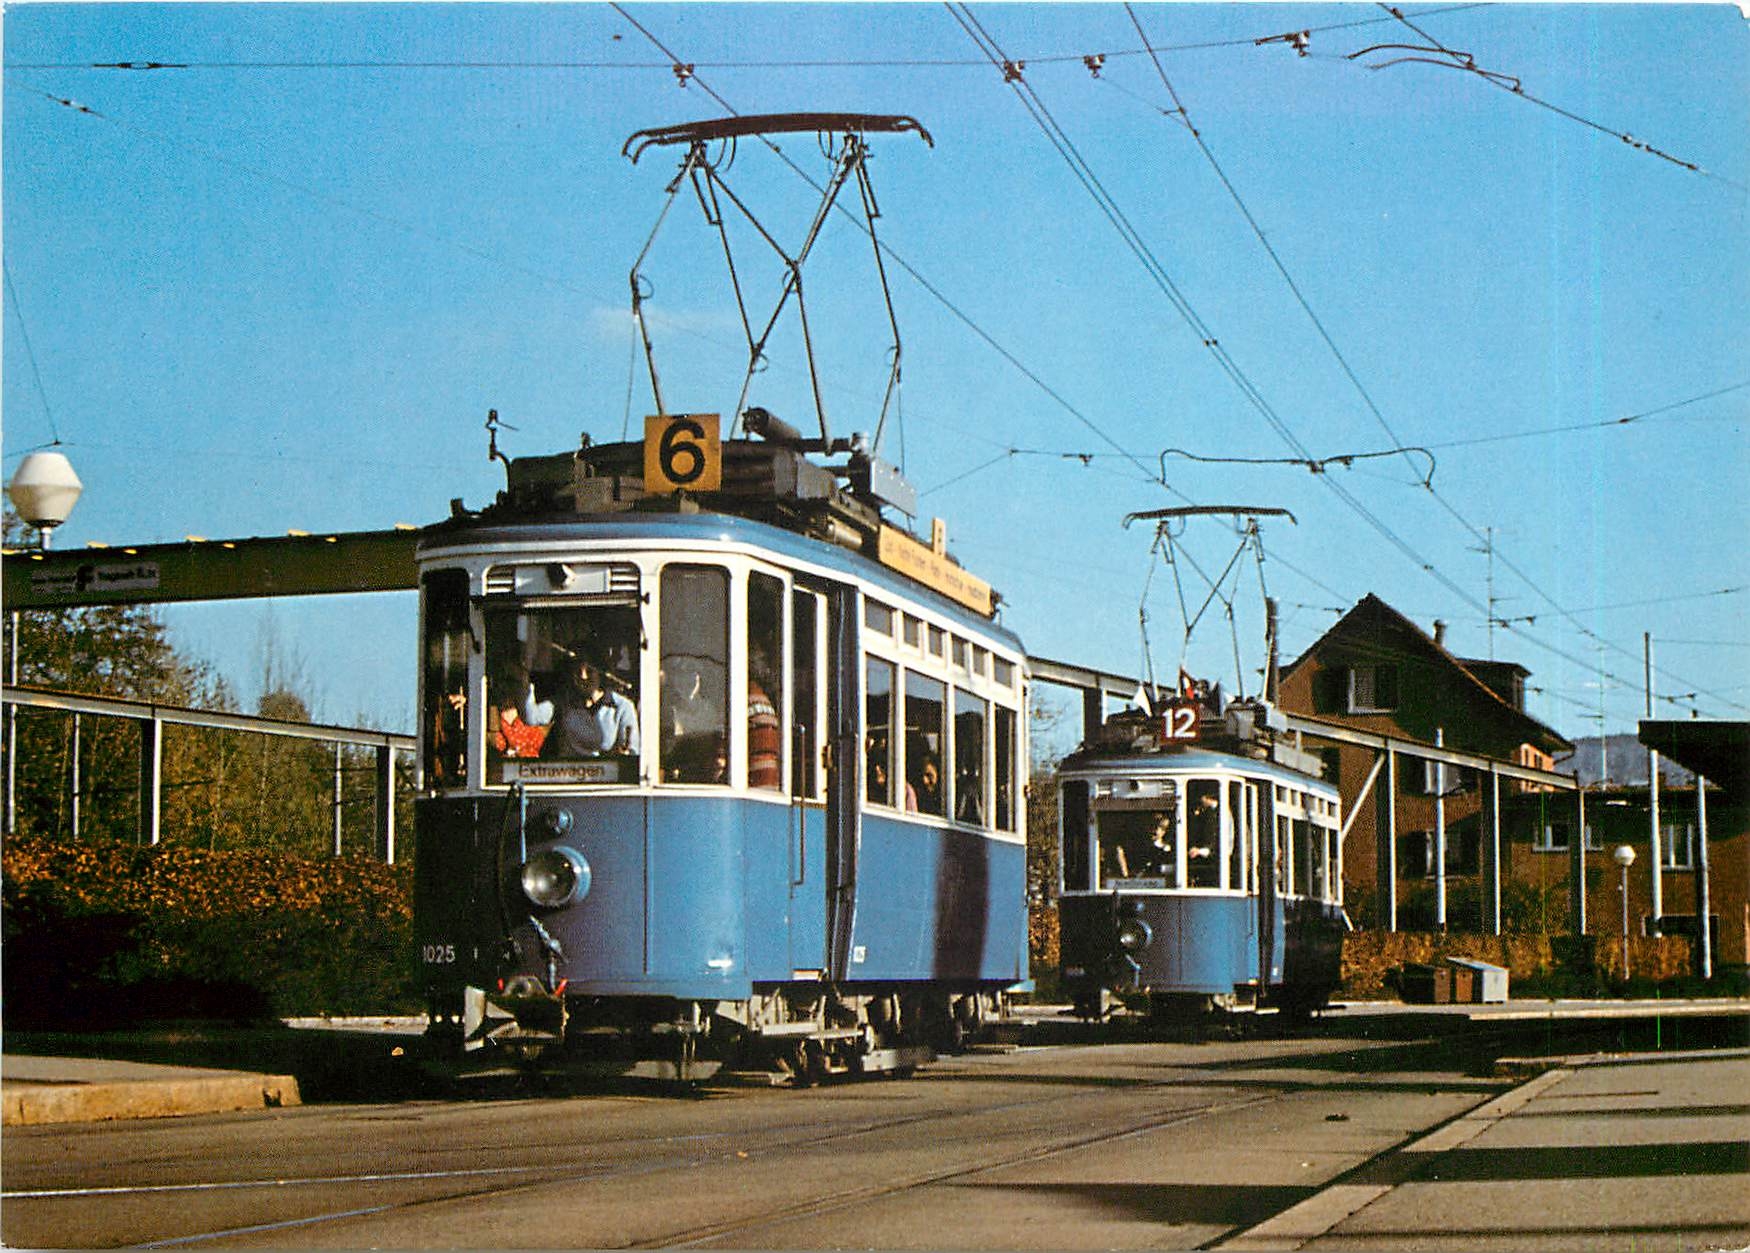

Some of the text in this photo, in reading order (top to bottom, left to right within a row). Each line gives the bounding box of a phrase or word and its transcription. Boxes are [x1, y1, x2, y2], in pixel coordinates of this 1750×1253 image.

[659, 419, 706, 485] 6
[1162, 707, 1197, 738] 12
[519, 765, 604, 781] Extrawagen
[423, 944, 456, 963] 1025
